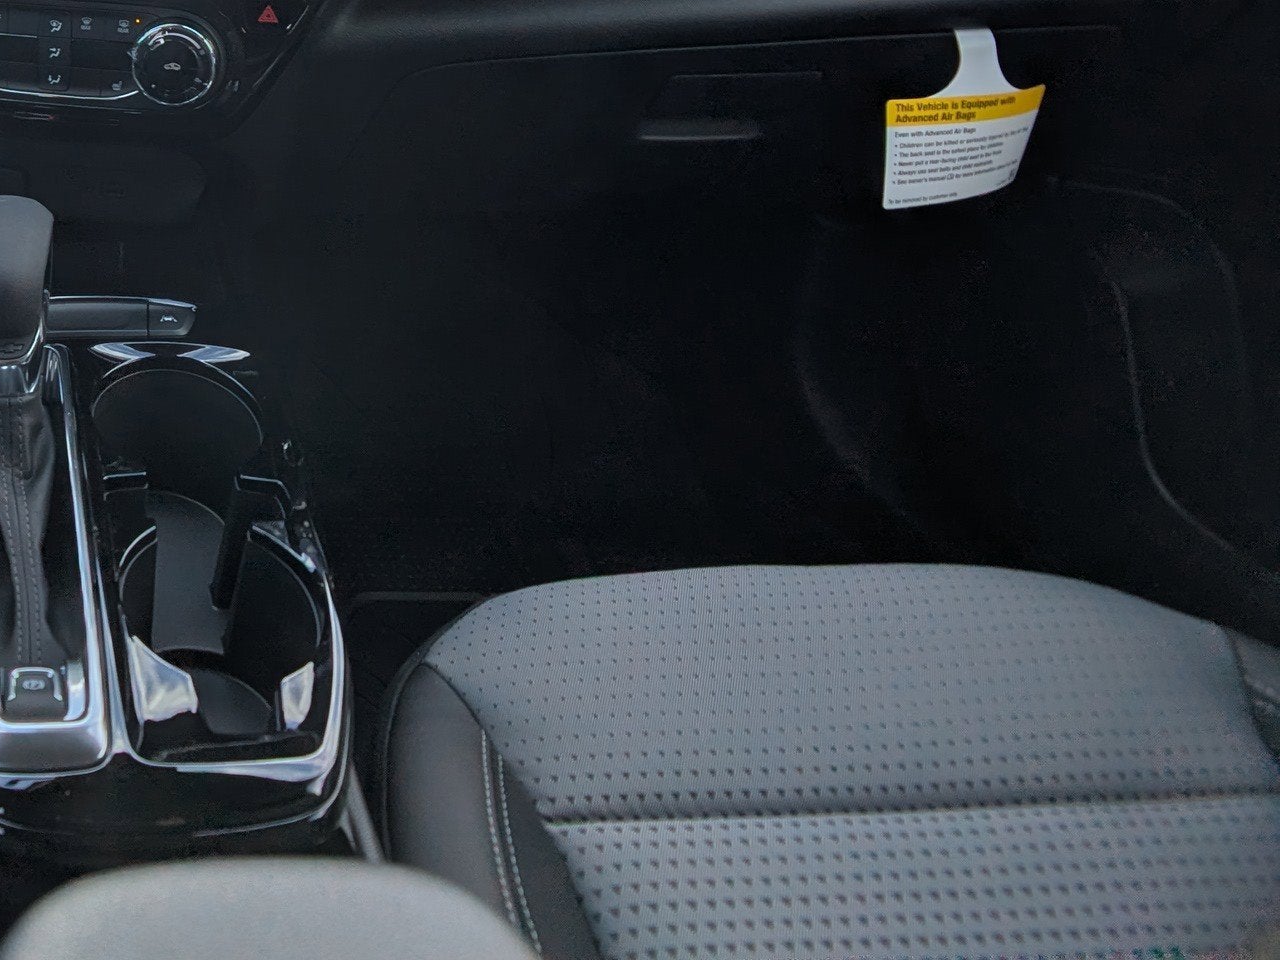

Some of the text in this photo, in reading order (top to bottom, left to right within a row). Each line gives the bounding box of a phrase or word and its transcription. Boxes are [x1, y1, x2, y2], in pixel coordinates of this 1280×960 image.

[895, 96, 1016, 112] This Vehicle is Equipped with
[895, 111, 977, 123] Advanced Air Bags
[924, 129, 953, 137] Advanced
